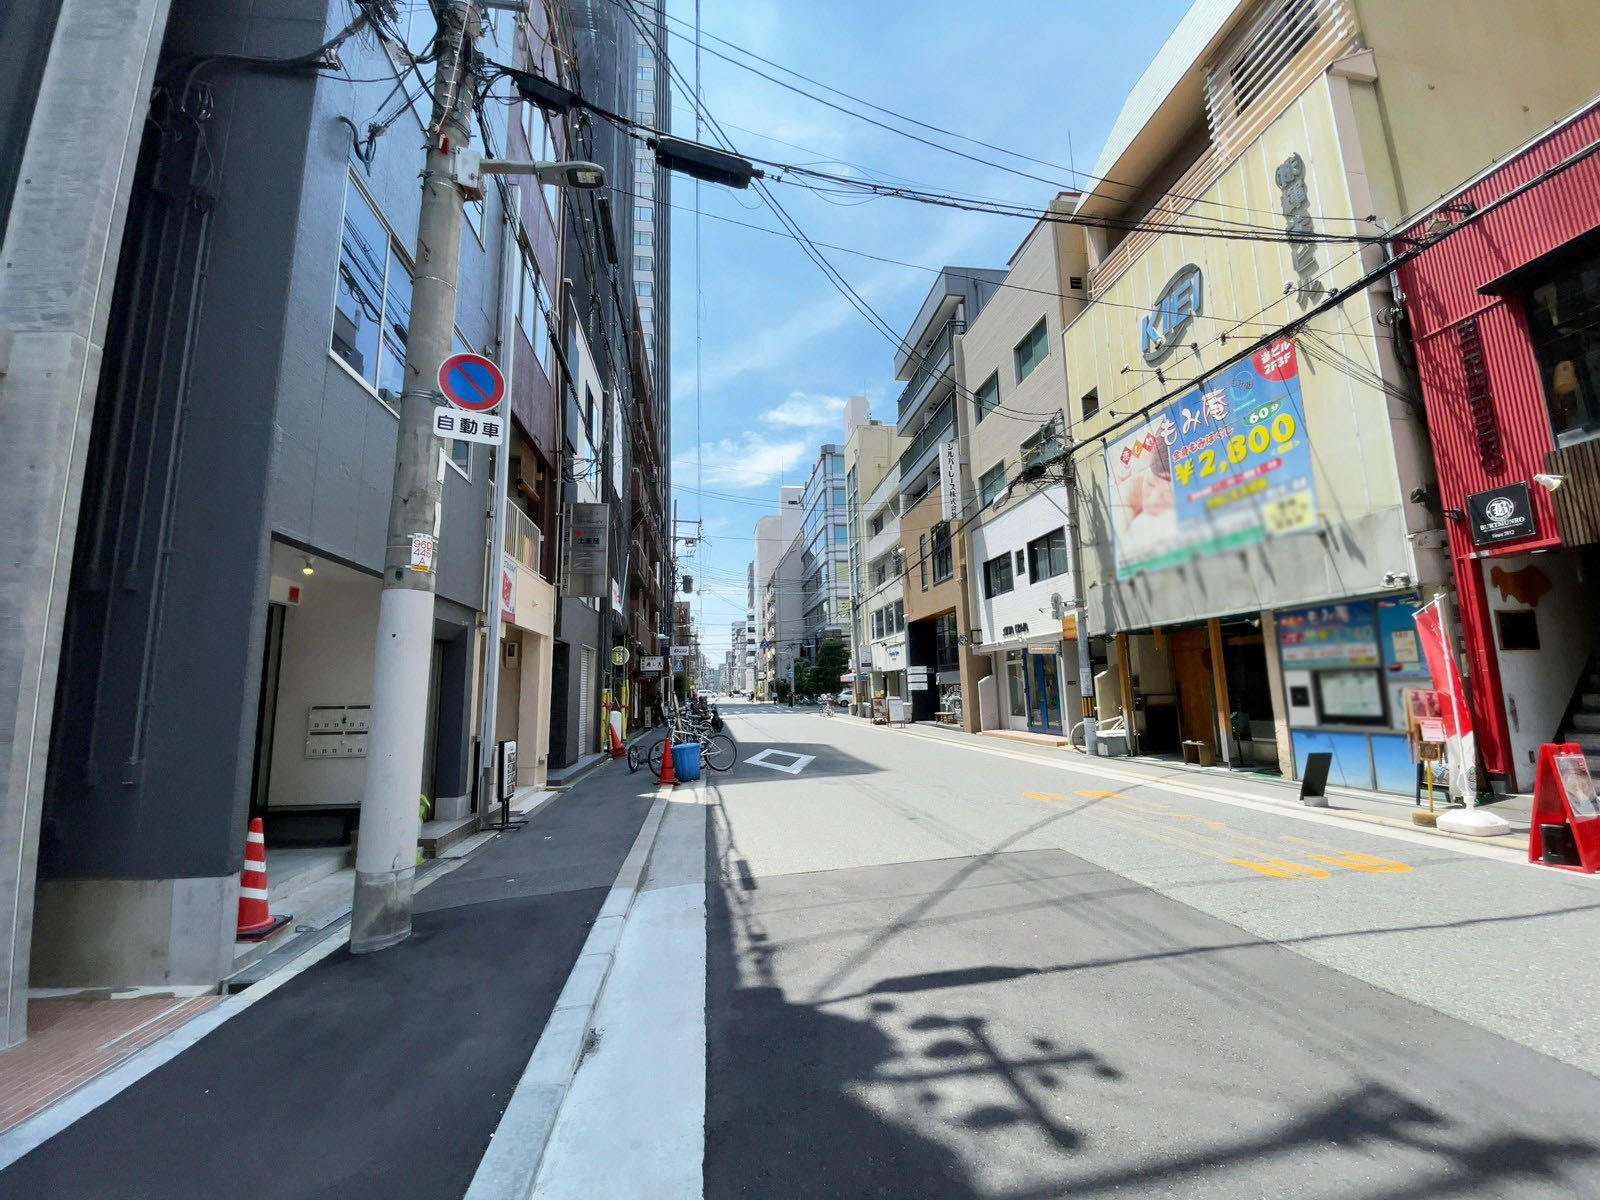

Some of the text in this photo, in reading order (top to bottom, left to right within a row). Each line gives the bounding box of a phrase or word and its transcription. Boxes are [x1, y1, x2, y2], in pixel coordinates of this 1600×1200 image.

[1264, 352, 1291, 375] 2F3F
[438, 415, 499, 437] 自動車
[1161, 387, 1229, 446] もみ庵
[1175, 413, 1295, 485] ¥2,800
[947, 443, 958, 519] シルバーレース株式会社
[1479, 516, 1526, 531] BURTMUNRO
[413, 539, 433, 550] 96D
[413, 548, 432, 558] 445
[418, 557, 426, 565] A
